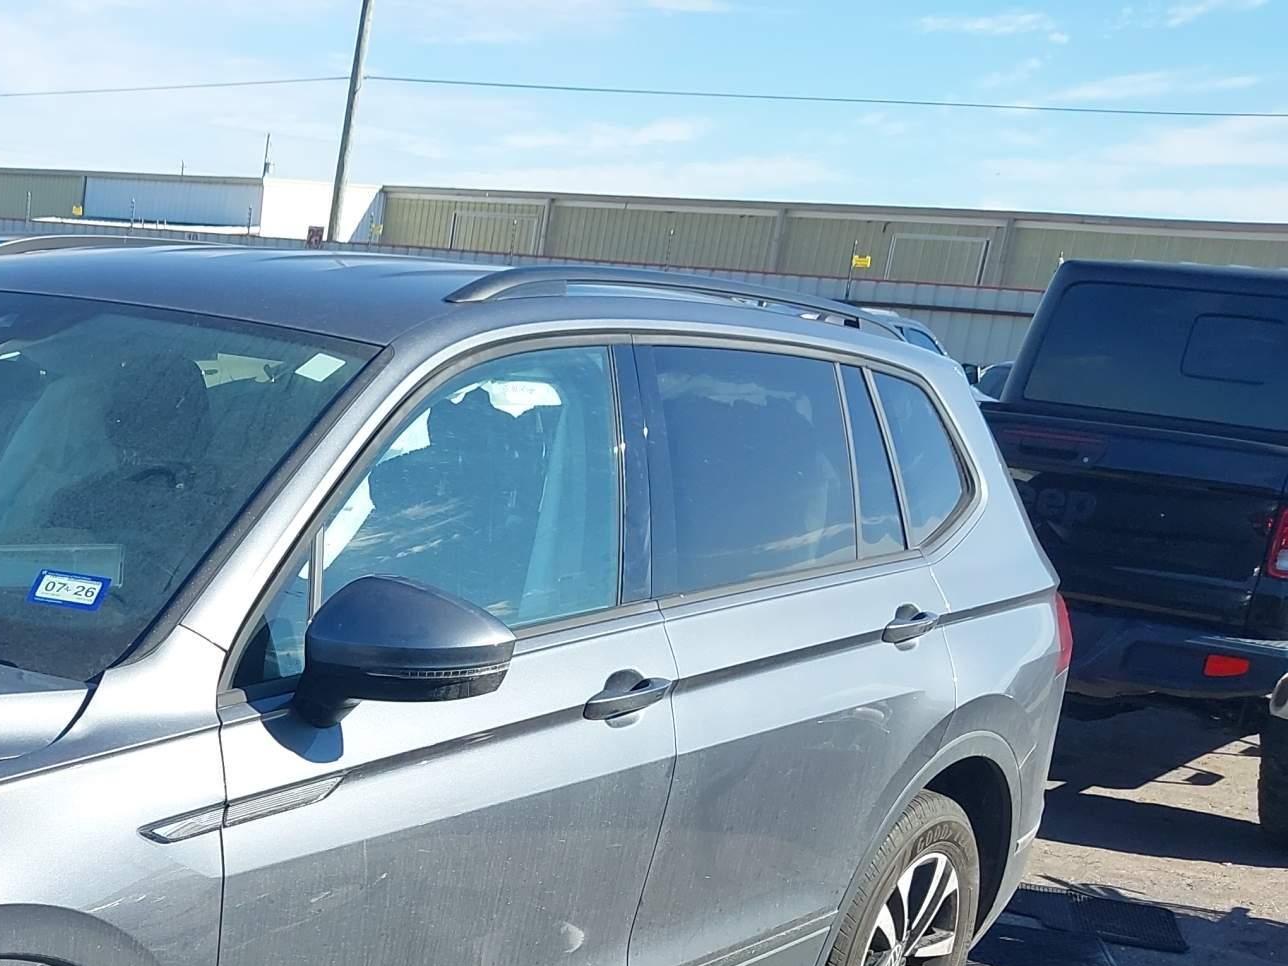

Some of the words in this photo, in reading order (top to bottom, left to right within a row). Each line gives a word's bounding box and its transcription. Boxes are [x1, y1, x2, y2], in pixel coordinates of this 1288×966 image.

[1019, 482, 1098, 529] eep
[44, 581, 67, 593] 07
[73, 585, 97, 598] 26
